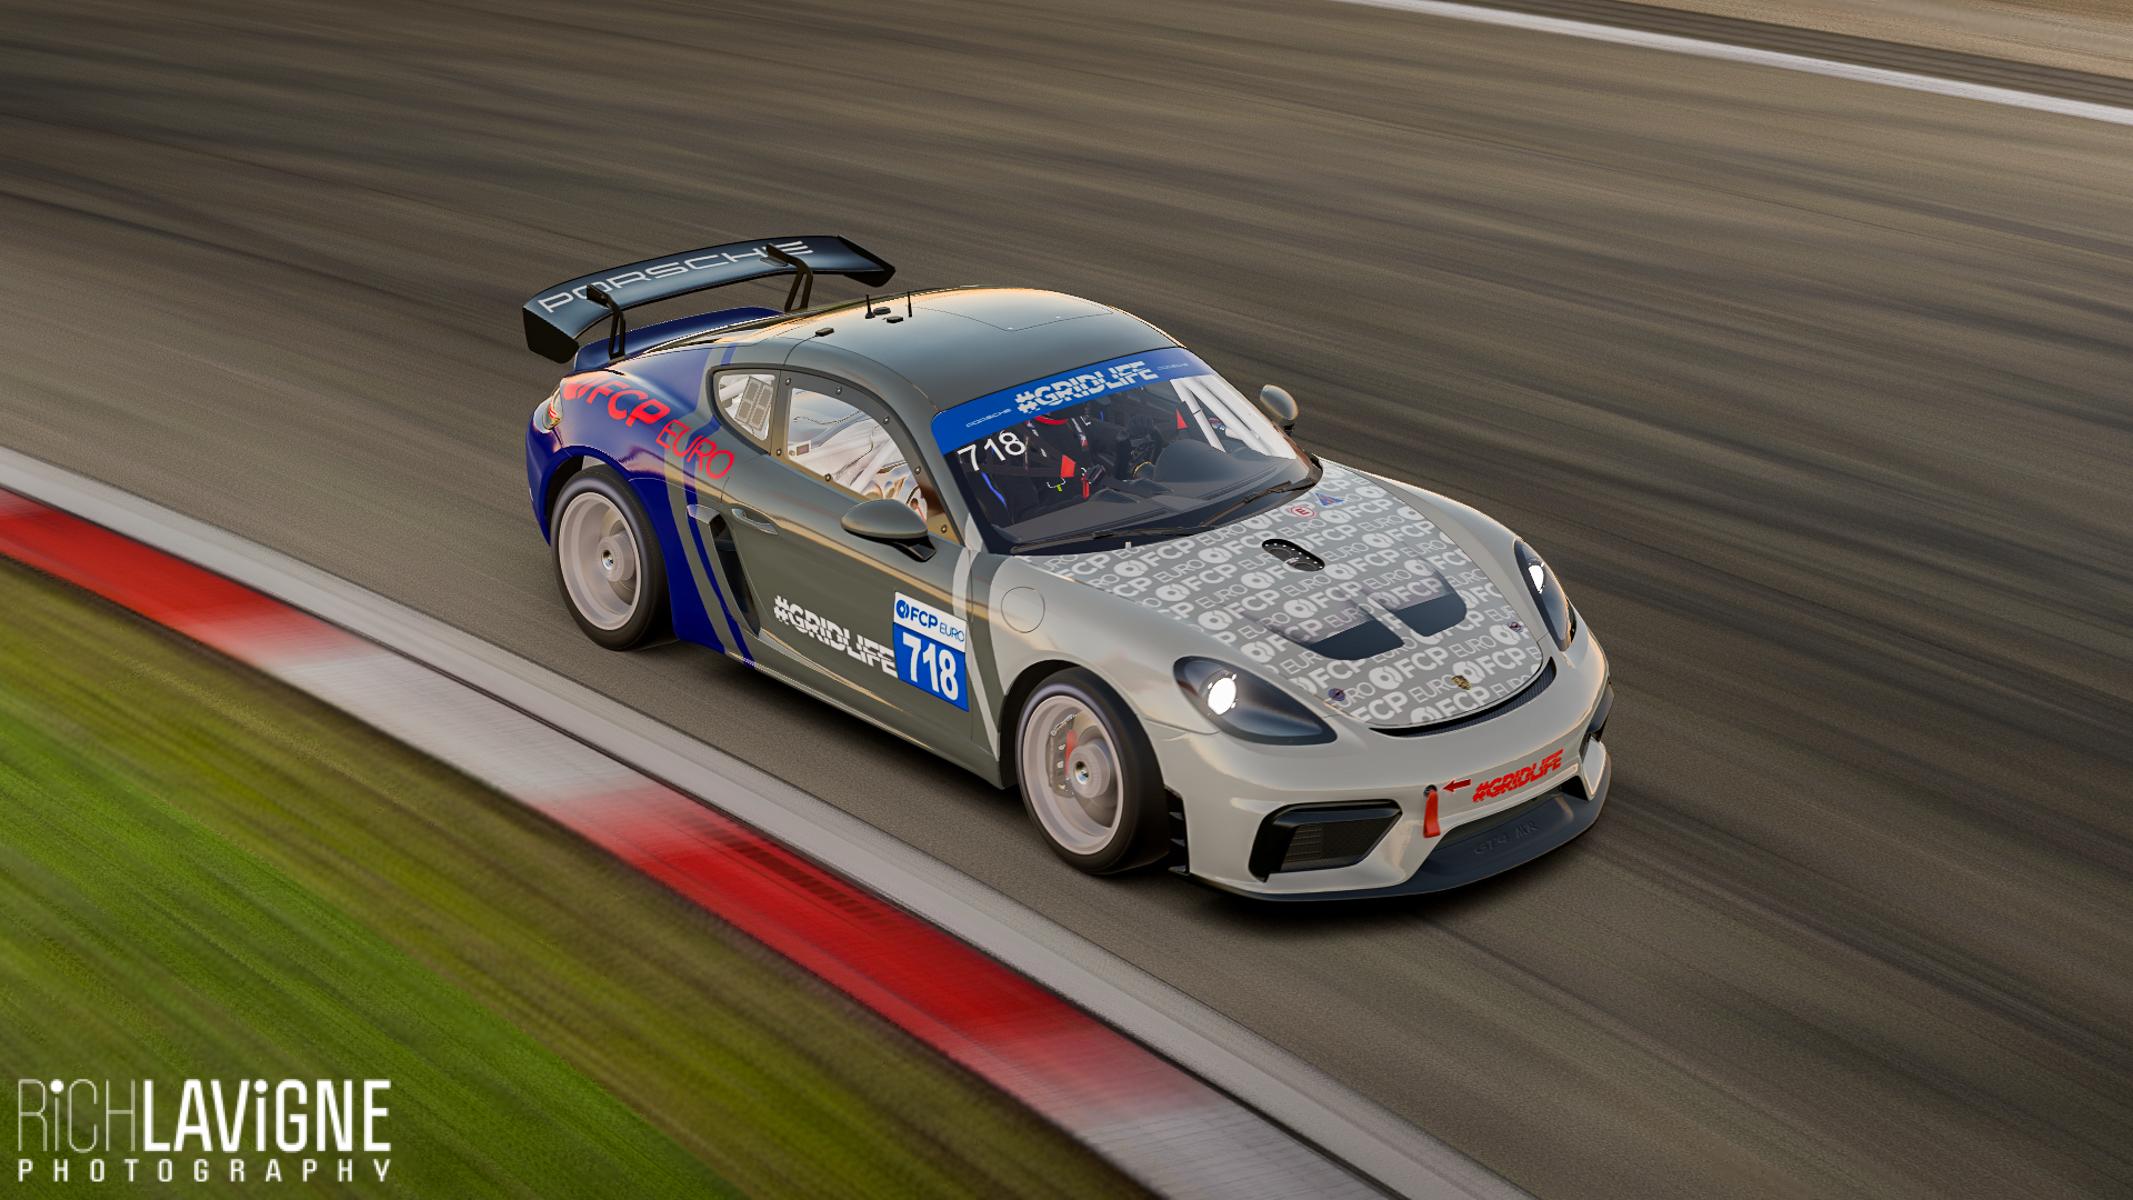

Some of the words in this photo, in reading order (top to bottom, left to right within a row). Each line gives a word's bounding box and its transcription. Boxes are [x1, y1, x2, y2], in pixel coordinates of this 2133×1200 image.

[538, 241, 813, 313] PORSCHE
[1015, 361, 1159, 413] #GRIDLIFE
[586, 381, 671, 427] FCP
[656, 419, 734, 479] EURO
[957, 431, 1026, 471] 718
[1318, 479, 1352, 492] CP
[1086, 574, 1120, 588] RO
[1140, 539, 1196, 567] FCP
[1197, 524, 1248, 546] EURO
[1112, 577, 1153, 598] CP
[1152, 560, 1207, 583] EURO
[1223, 530, 1277, 555] FCP
[1279, 518, 1327, 538] EURO
[1343, 499, 1393, 517] FCP
[1181, 564, 1238, 592] FCP
[1305, 525, 1358, 547] FCP
[1357, 514, 1405, 533] EURO
[1195, 584, 1249, 609] EURO
[1321, 542, 1369, 562] EURO
[1384, 520, 1436, 542] FCP
[1223, 590, 1281, 619] FCP
[1280, 573, 1332, 597] EURO
[1348, 549, 1401, 572] FCP
[1307, 581, 1364, 608] FCP
[1363, 569, 1413, 591] EURO
[1391, 578, 1442, 602] FCP
[773, 595, 898, 679] #GRIDLIFE
[910, 610, 938, 629] FCP
[939, 622, 965, 643] EURO
[1280, 650, 1325, 675] EUR
[1470, 583, 1504, 603] FC
[902, 632, 959, 701] 718
[1394, 646, 1449, 679] FCP
[1448, 635, 1498, 658] EURO
[1475, 647, 1527, 675] FCP
[1435, 687, 1491, 718] FCP
[1472, 748, 1564, 803] #GRIDLIFE
